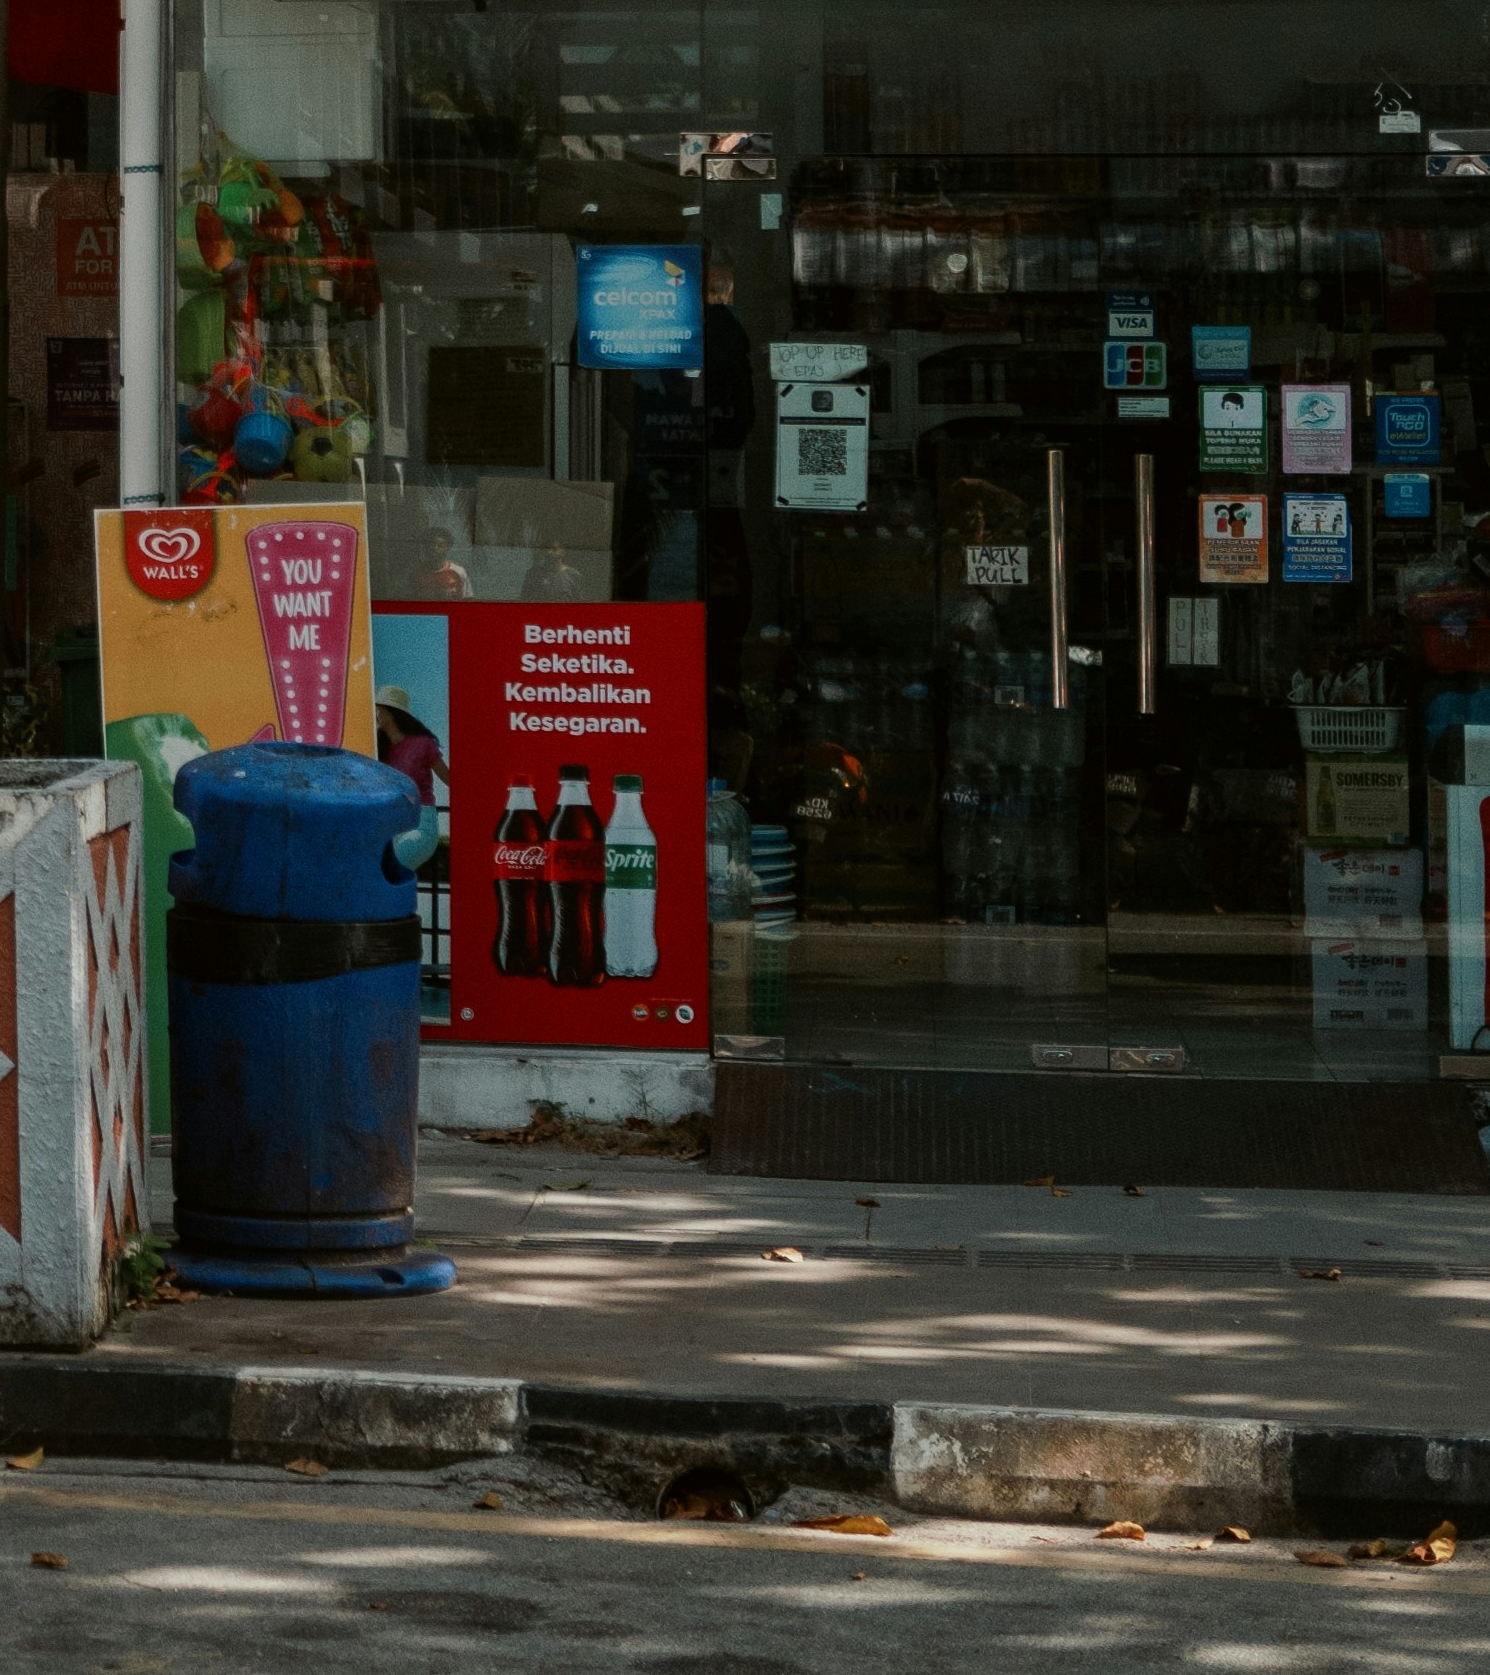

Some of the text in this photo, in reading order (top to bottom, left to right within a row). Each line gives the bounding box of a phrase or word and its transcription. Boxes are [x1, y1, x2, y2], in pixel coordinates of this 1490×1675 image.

[75, 226, 118, 256] AT
[74, 259, 113, 275] FOR
[593, 287, 678, 307] celcom
[638, 309, 677, 321] XPAX
[1115, 317, 1148, 329] VISA
[774, 345, 865, 363] TOP UP HERE
[1107, 358, 1161, 373] JCB
[969, 547, 1021, 566] TARIK
[142, 565, 199, 580] WALL'S
[281, 559, 322, 586] YOU
[976, 567, 1024, 584] PULL
[274, 591, 333, 619] WANT
[288, 624, 321, 651] ME
[524, 624, 631, 645] Berhenti
[520, 653, 635, 674] Seketika.
[505, 682, 651, 704] Kembalikan
[510, 712, 647, 736] Kesegaran.
[1336, 771, 1403, 788] SOMERSBY
[495, 845, 546, 866] Coca-Cola
[605, 848, 655, 872] Sprite
